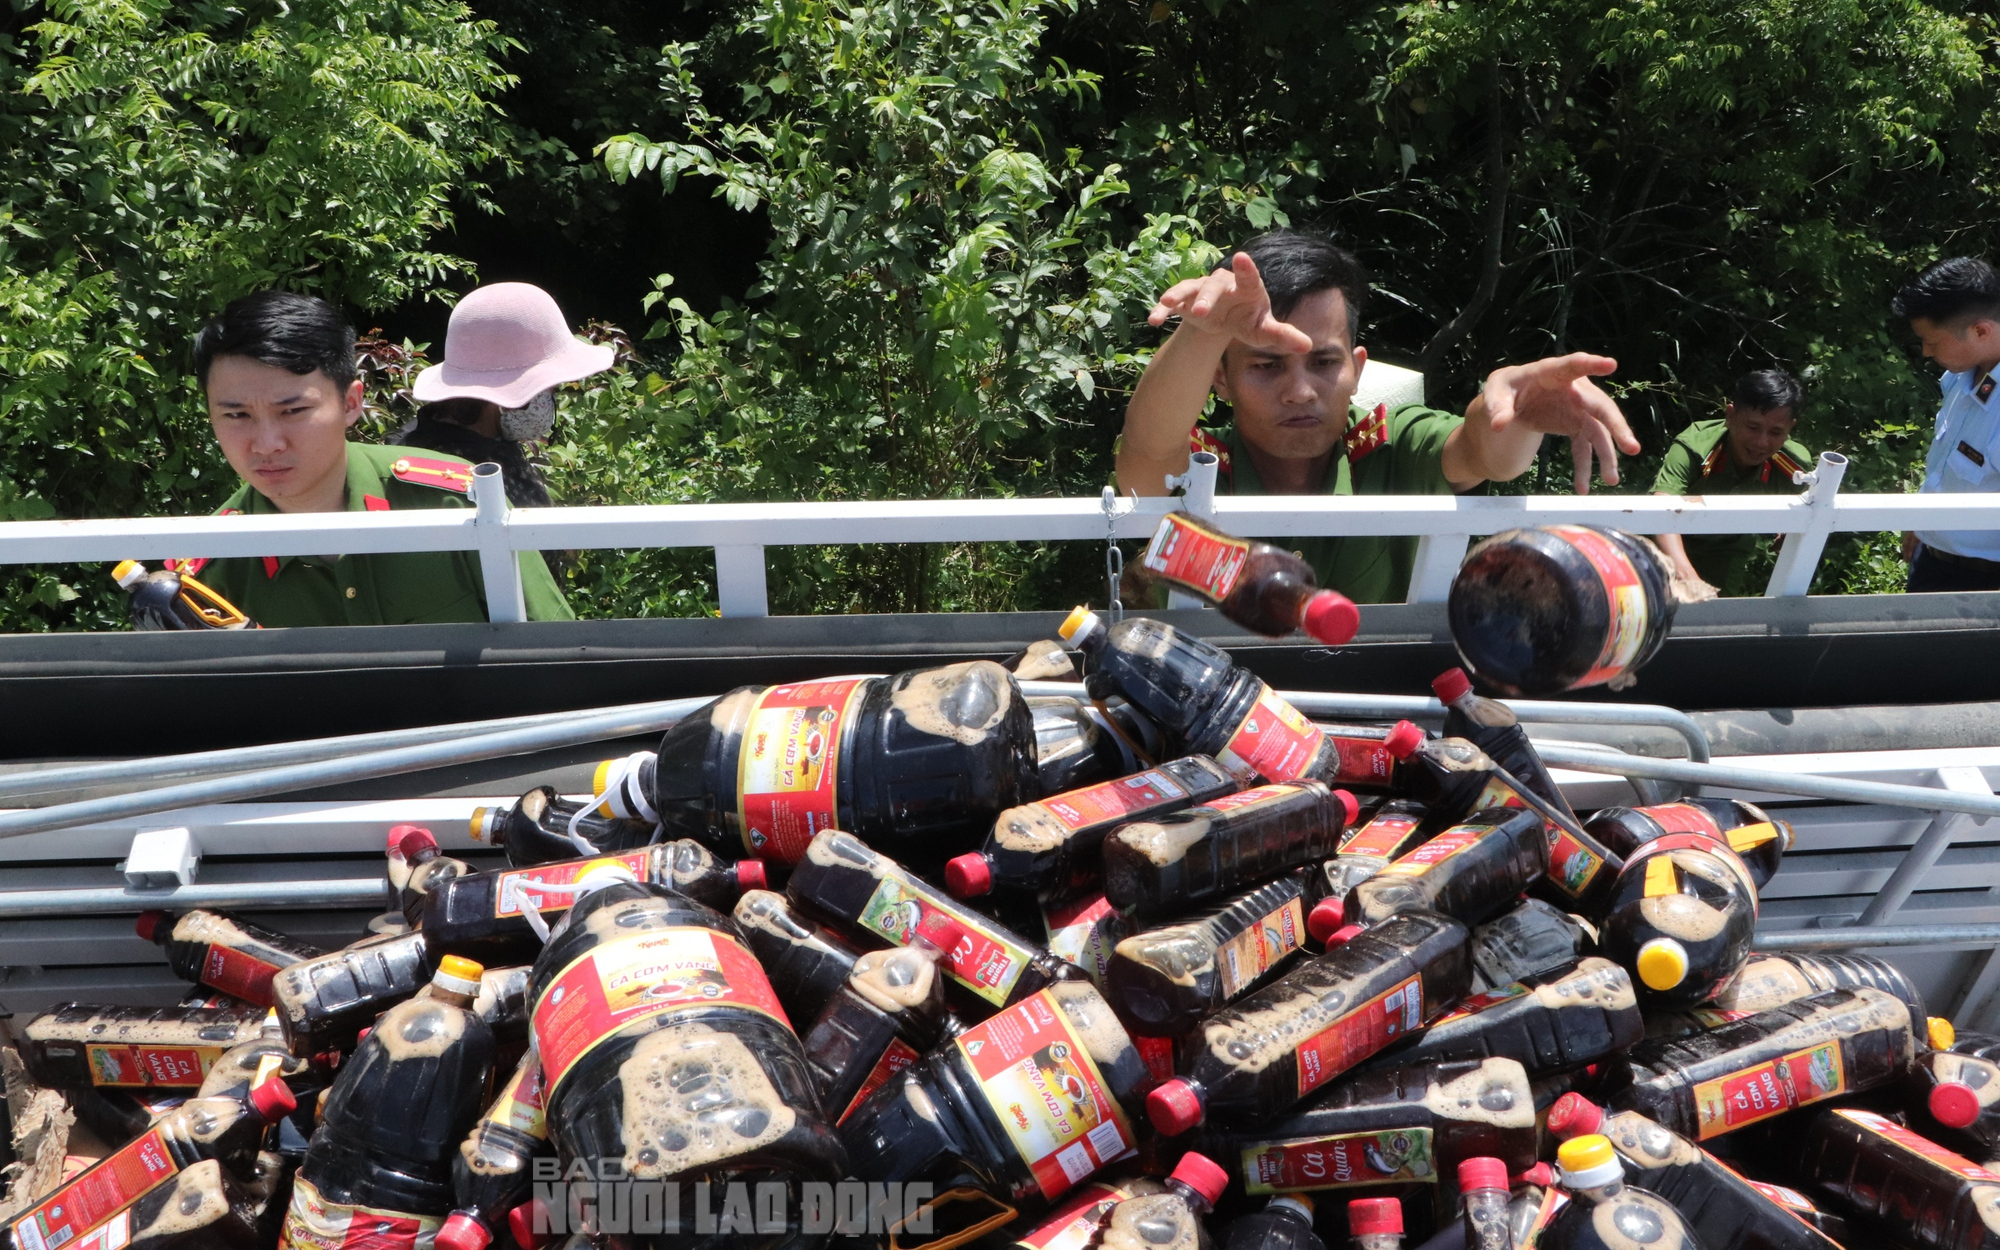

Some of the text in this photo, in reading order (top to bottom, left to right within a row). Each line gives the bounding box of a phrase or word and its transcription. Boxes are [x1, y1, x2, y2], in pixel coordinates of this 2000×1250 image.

[785, 738, 797, 767] CƠM
[782, 769, 794, 787] CÁ
[609, 975, 630, 991] CÁ
[634, 964, 670, 979] CƠM
[988, 958, 1009, 985] Thanh
[1022, 1058, 1046, 1091] VÀNG
[1733, 1089, 1749, 1110] CÁ
[1746, 1080, 1765, 1110] CƠM
[1760, 1071, 1781, 1109] VÀNG
[1041, 1091, 1064, 1119] CƠM
[1056, 1119, 1073, 1135] CÁ
[139, 1152, 157, 1173] VÀNG
[143, 1142, 166, 1170] CÁ CƠM
[1302, 1150, 1326, 1178] Cá
